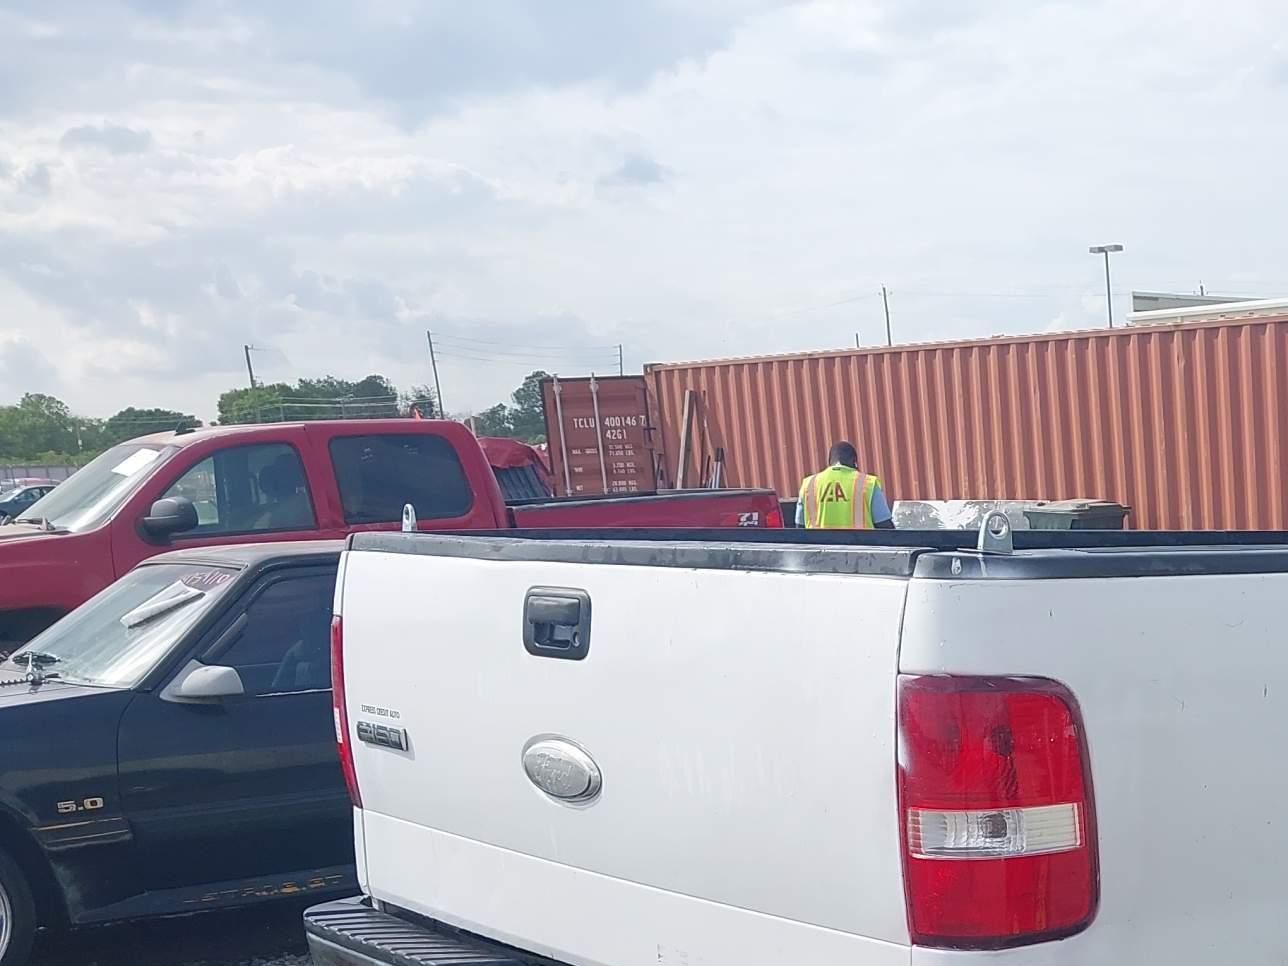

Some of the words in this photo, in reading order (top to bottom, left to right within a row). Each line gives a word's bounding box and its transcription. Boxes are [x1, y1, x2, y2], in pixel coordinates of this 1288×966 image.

[572, 417, 595, 428] TCLU
[604, 416, 637, 427] 400146
[605, 430, 627, 440] 42G1
[57, 797, 104, 813] 5.0
